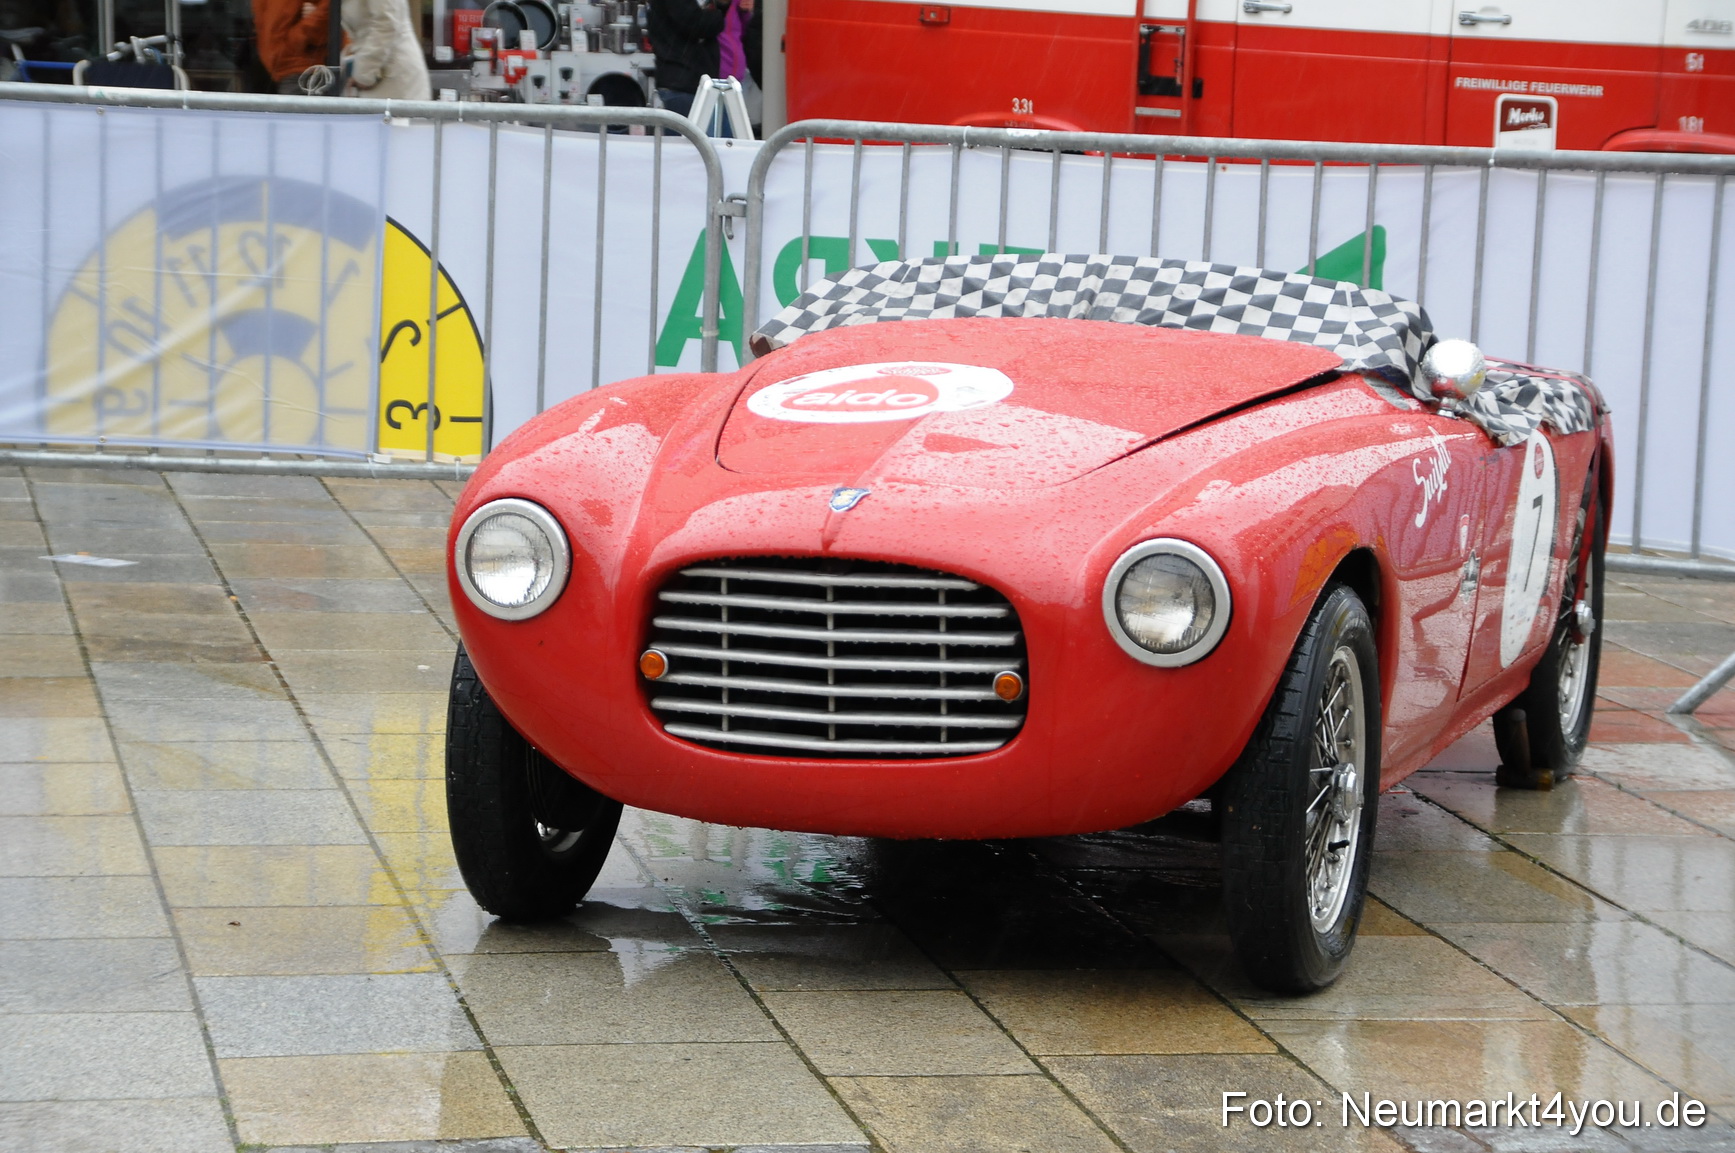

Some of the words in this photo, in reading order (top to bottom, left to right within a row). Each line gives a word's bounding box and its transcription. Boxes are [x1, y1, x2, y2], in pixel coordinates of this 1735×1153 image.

[1685, 52, 1704, 72] 5t
[1455, 77, 1528, 91] FREIWILLIGE
[1530, 81, 1604, 96] FEUERWEHR
